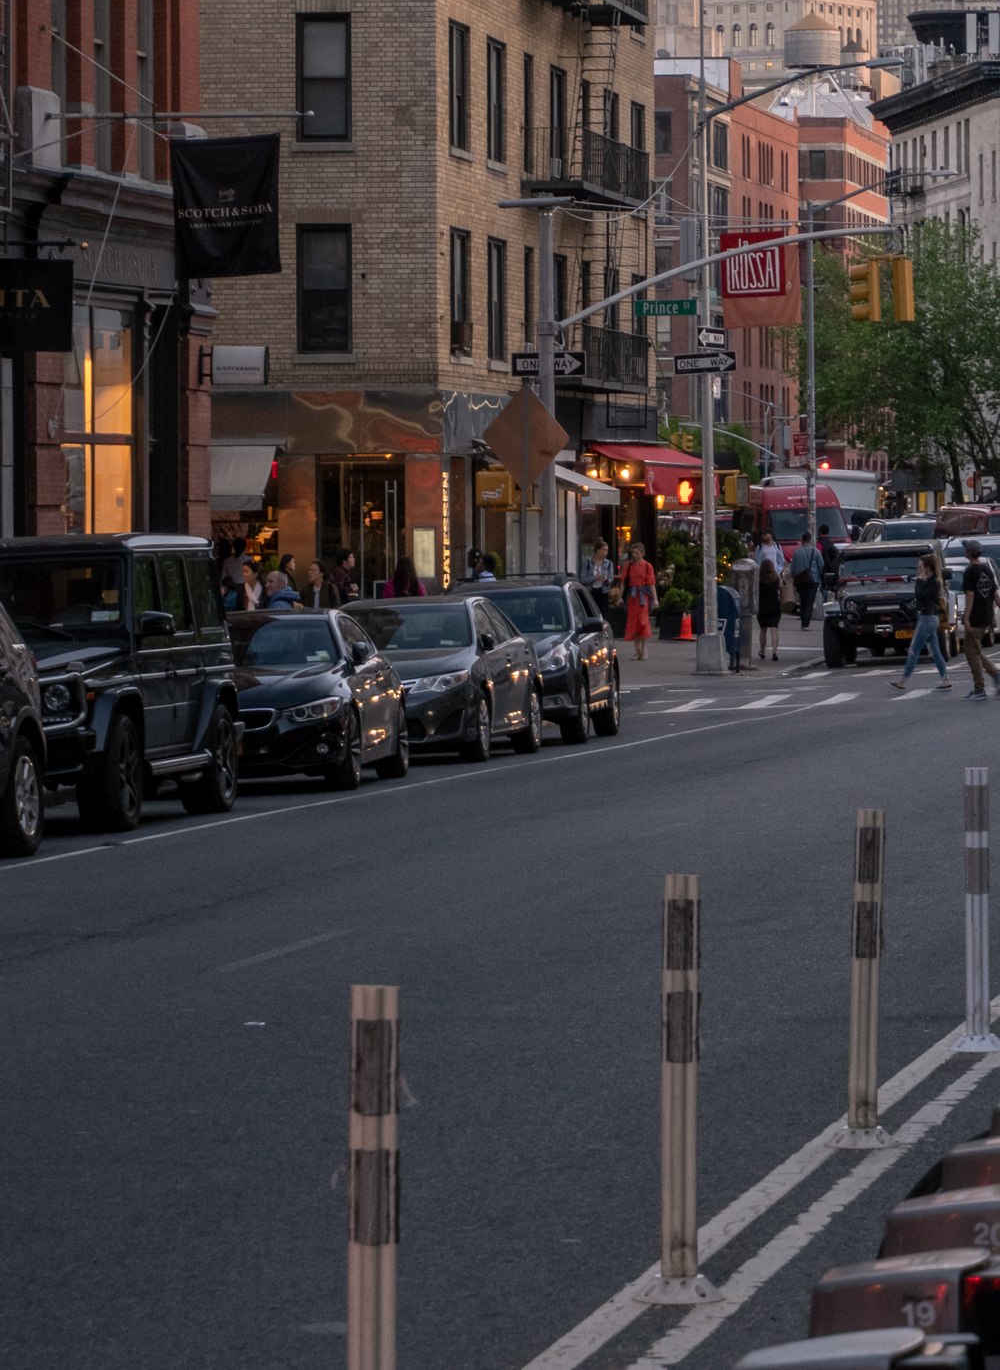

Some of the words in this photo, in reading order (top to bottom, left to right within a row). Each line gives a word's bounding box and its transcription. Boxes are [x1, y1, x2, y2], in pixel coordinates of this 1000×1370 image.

[731, 252, 775, 289] ROSSA
[643, 302, 679, 314] Prince
[682, 301, 691, 310] St
[702, 334, 711, 342] ONE
[522, 360, 540, 369] ON
[680, 360, 699, 369] ONE
[711, 358, 728, 366] WAY
[902, 1301, 936, 1327] 19
